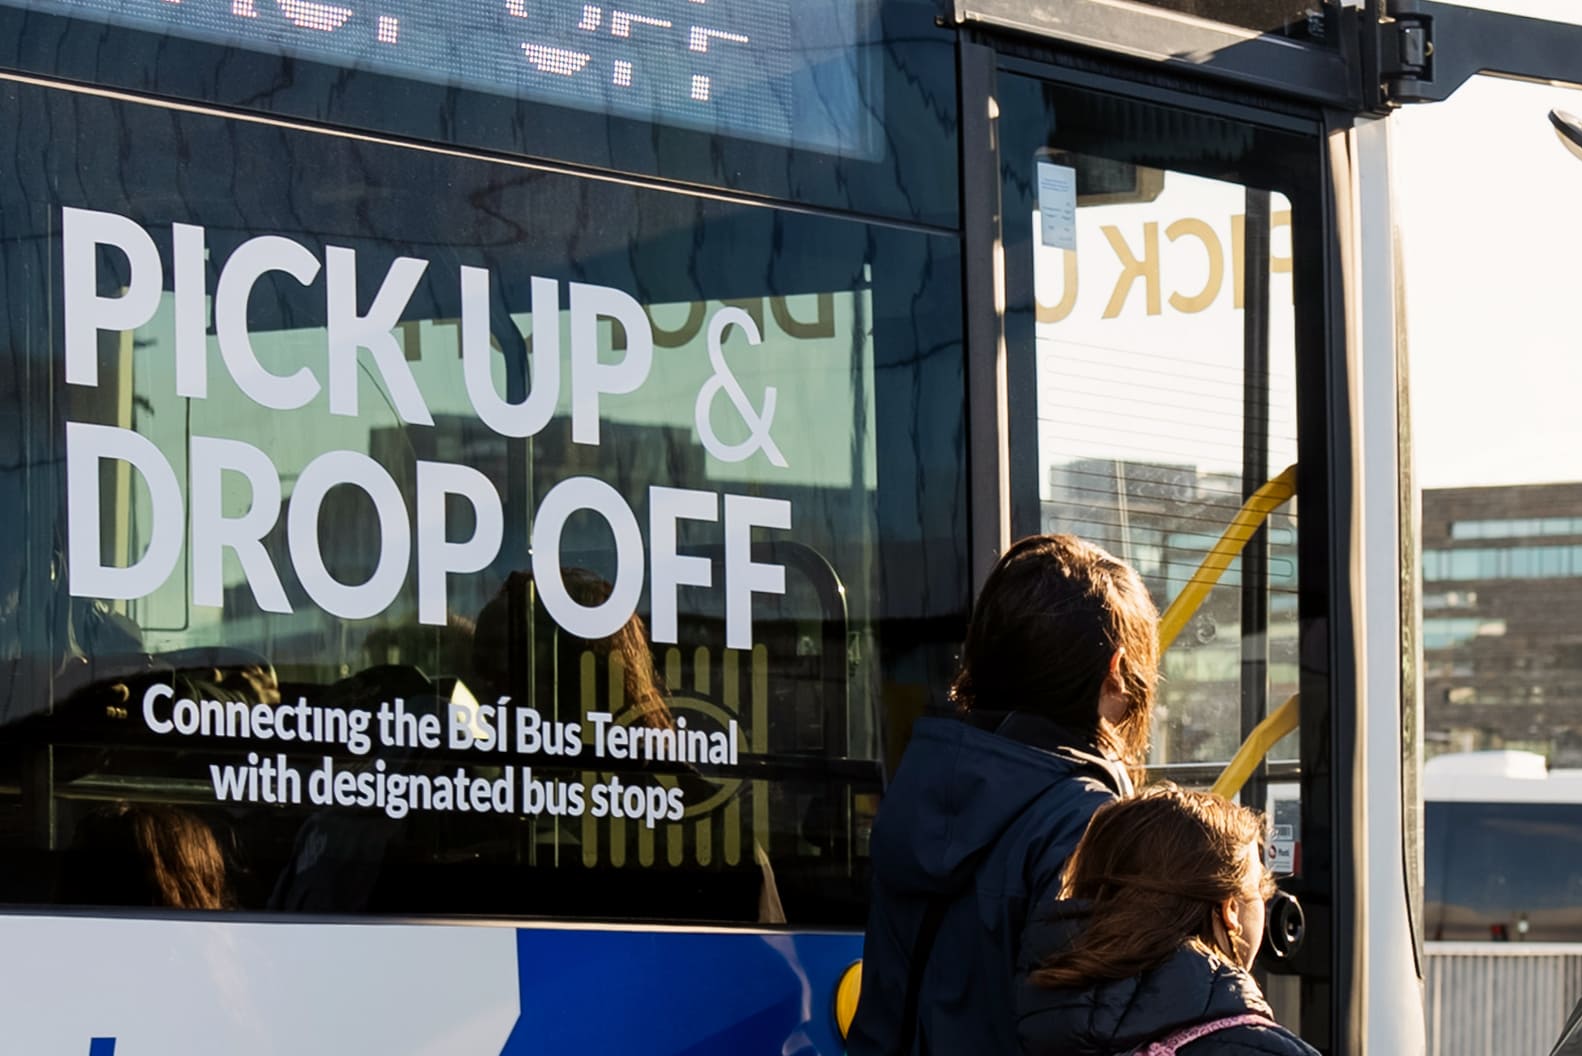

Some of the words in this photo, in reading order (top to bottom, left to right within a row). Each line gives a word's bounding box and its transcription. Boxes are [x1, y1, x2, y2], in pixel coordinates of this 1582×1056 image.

[62, 206, 435, 426] PICK
[460, 265, 653, 446] UP
[694, 306, 789, 468] &
[66, 421, 504, 626] DROP
[532, 476, 791, 650] OFF
[143, 683, 371, 755] Connecting
[378, 698, 441, 748] the
[448, 696, 511, 752] BSÍ
[516, 706, 582, 757] Bus
[587, 711, 738, 766] Terminal
[209, 752, 301, 804] with
[309, 756, 514, 819] designated
[522, 766, 585, 818] bus
[591, 776, 684, 829] stops
